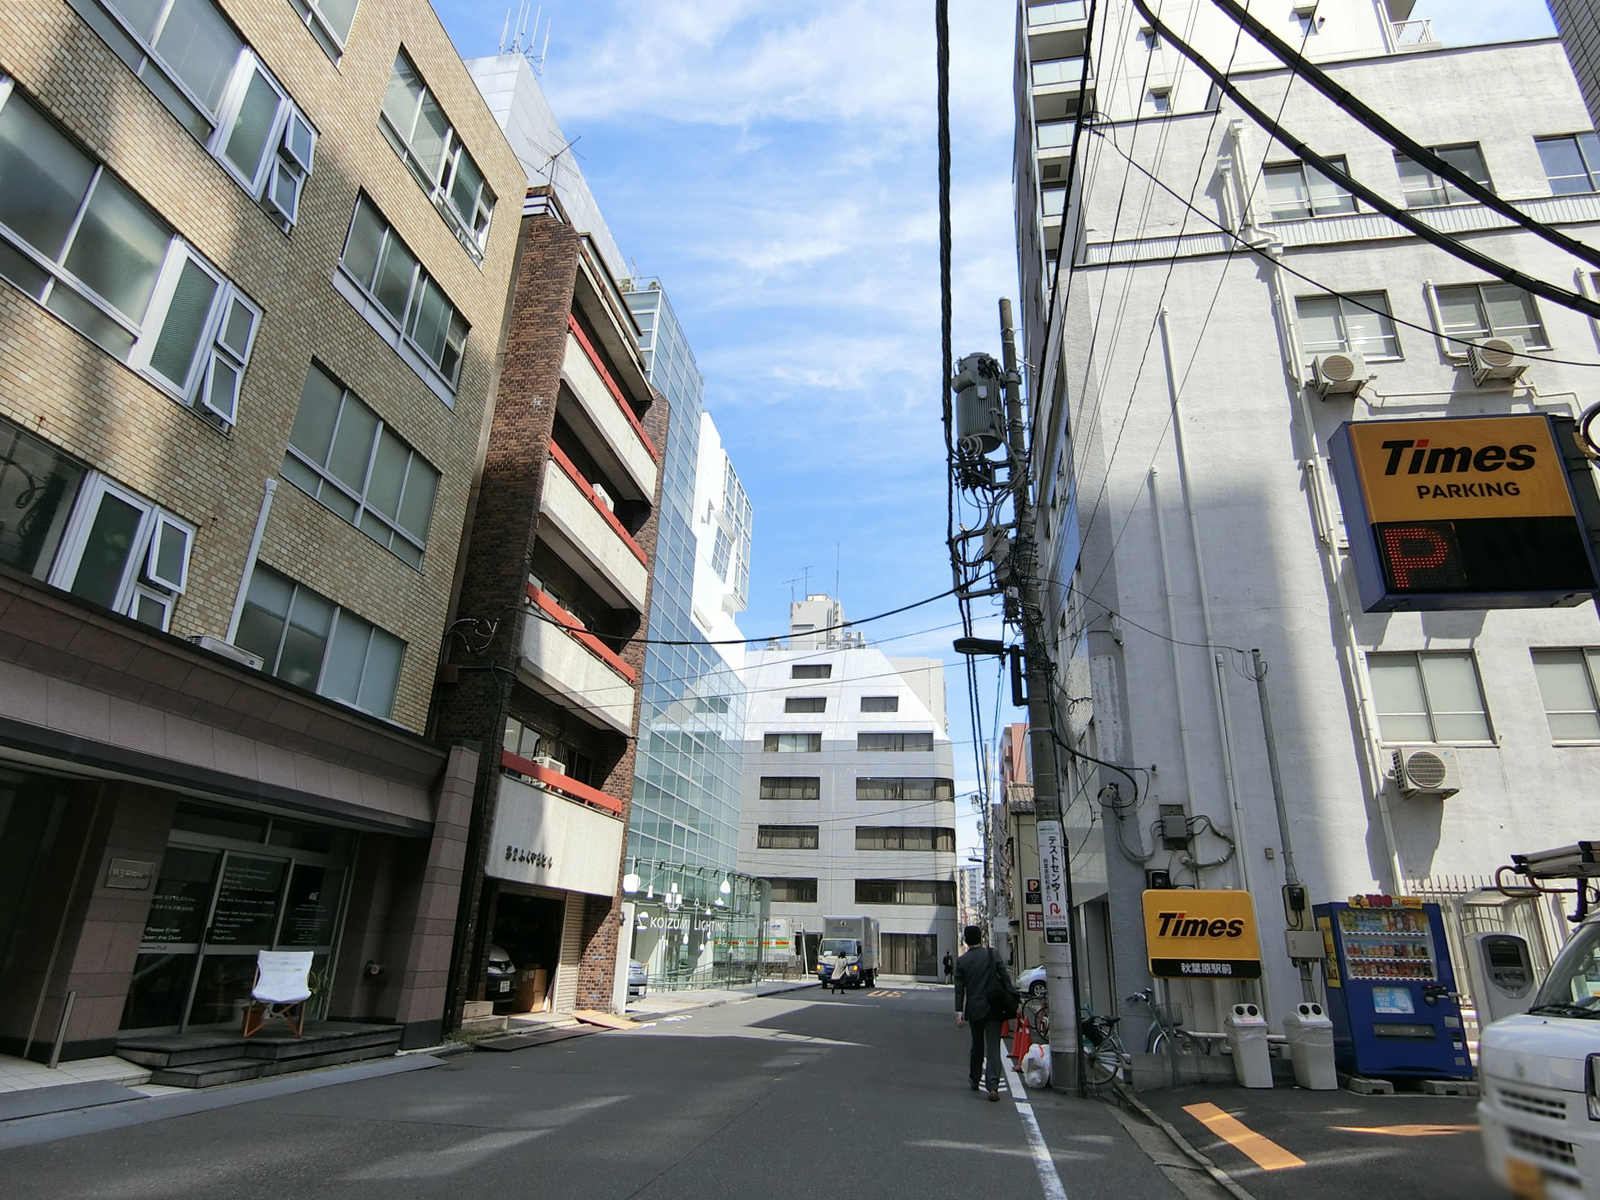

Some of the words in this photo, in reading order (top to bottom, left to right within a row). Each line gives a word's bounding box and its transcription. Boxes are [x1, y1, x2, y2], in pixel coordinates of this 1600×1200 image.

[1381, 439, 1537, 476] Times
[1416, 481, 1521, 499] PARKING
[1384, 528, 1447, 588] P
[1048, 836, 1061, 901] テストセンター
[650, 917, 690, 930] KOIZUMI
[694, 918, 726, 932] LIGHTING
[1158, 912, 1244, 938] Times
[1180, 963, 1232, 975] 秋葉原駅前
